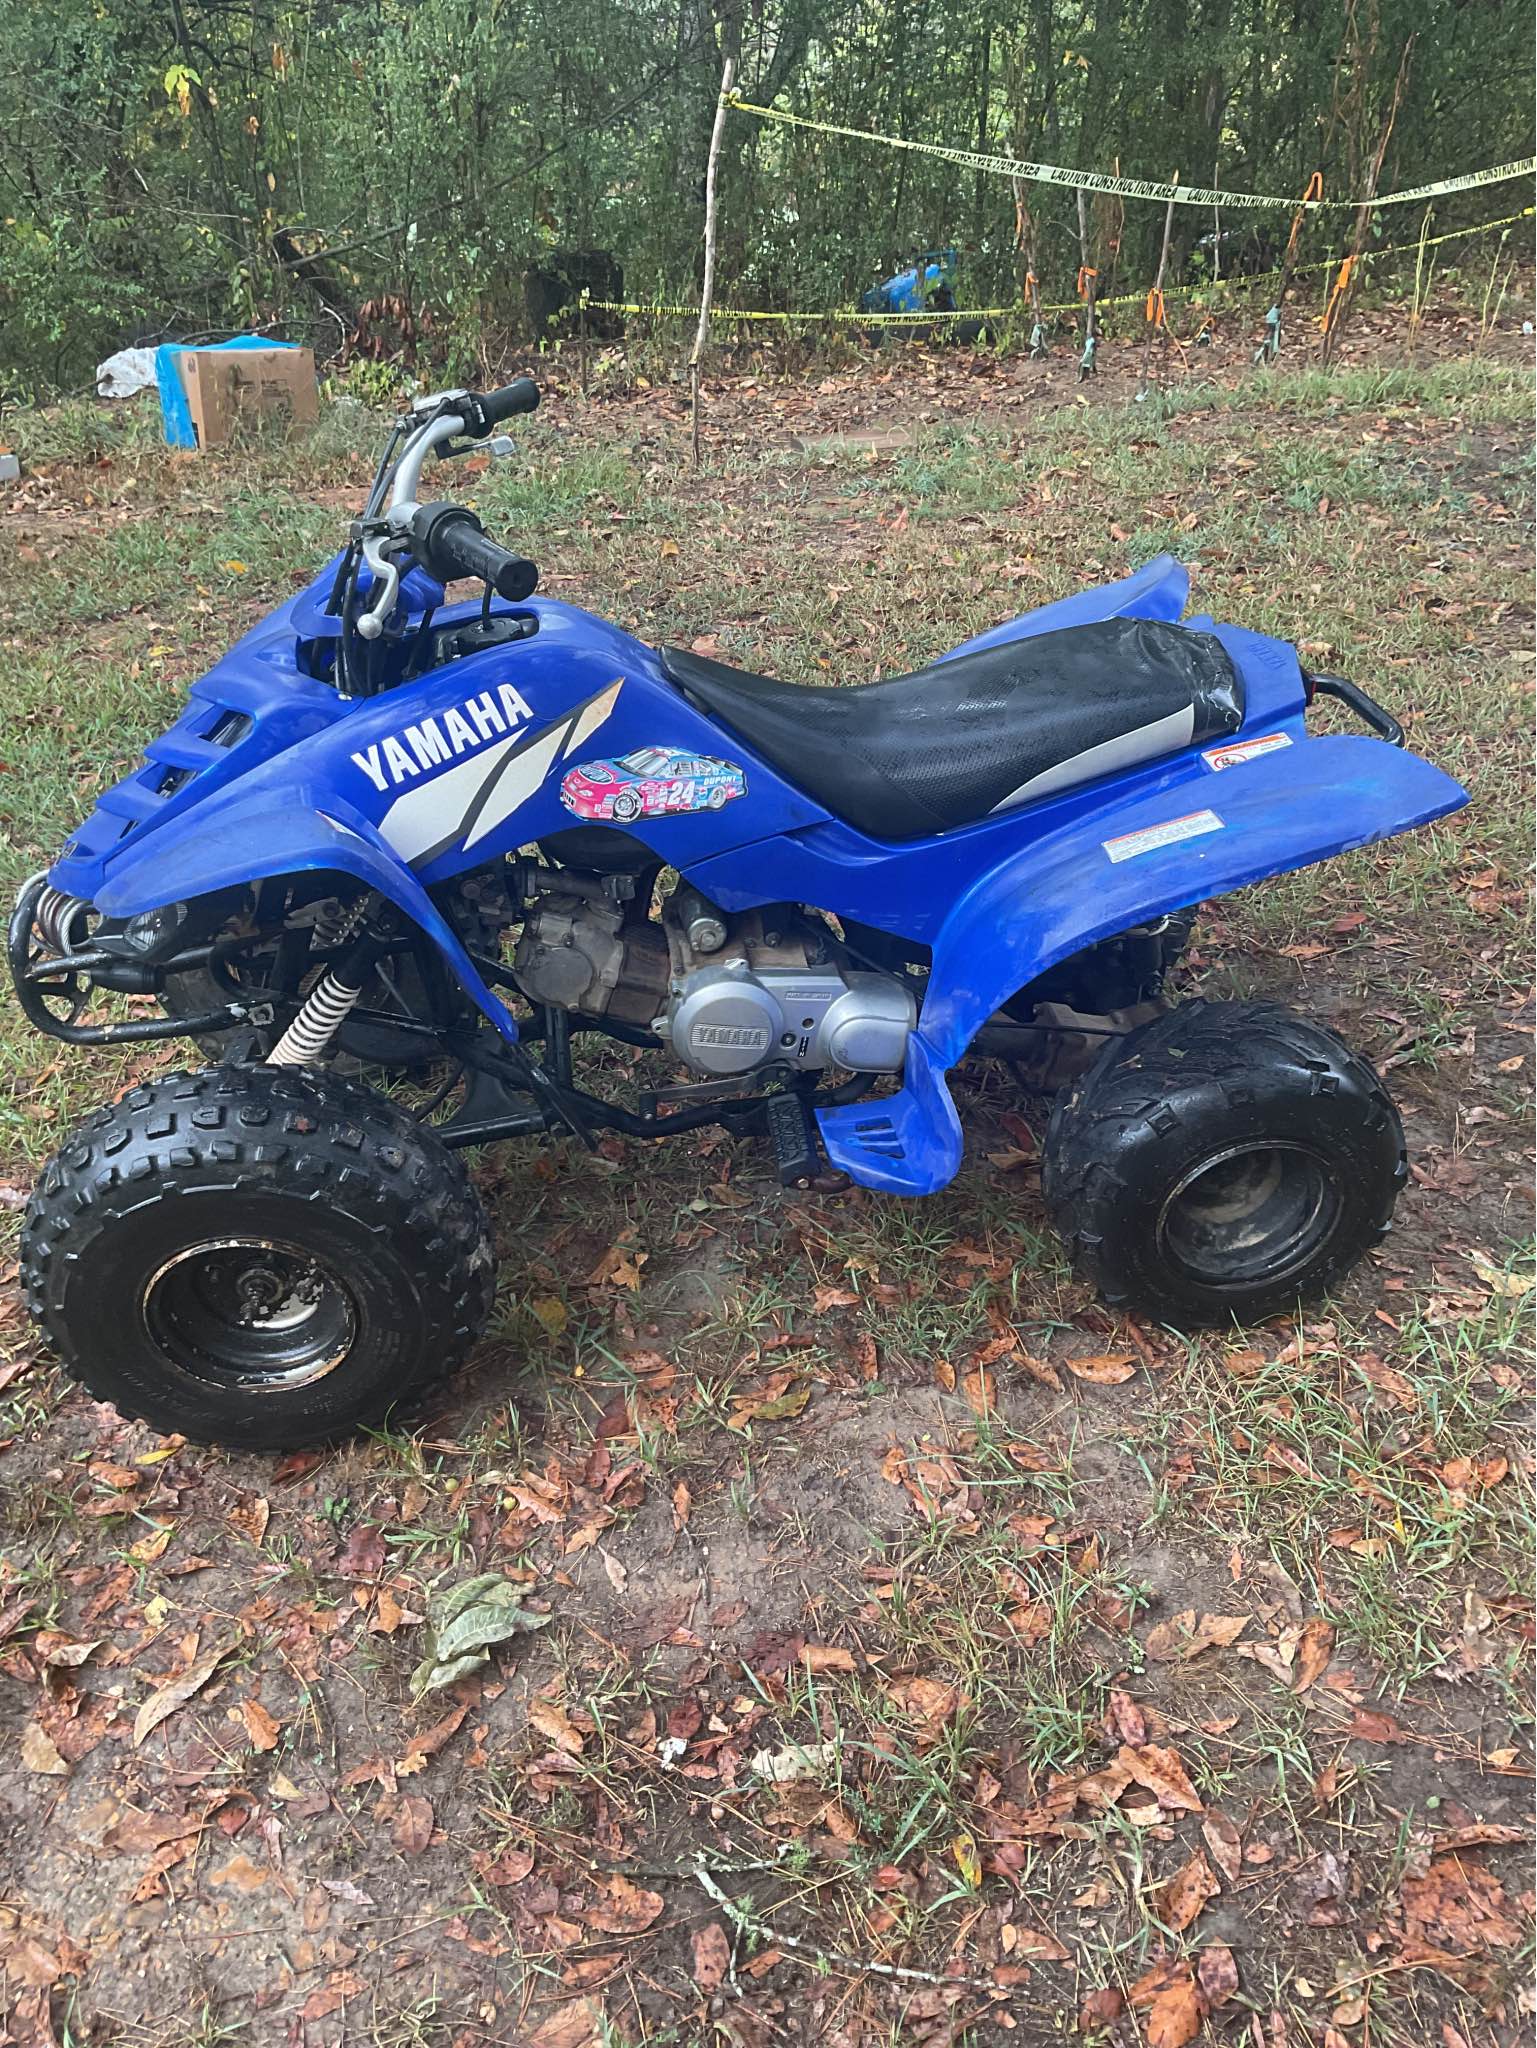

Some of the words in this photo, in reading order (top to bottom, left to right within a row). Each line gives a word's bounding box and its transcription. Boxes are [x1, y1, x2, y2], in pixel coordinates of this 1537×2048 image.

[1478, 159, 1534, 182] CONSTRUCTION
[1050, 168, 1091, 186] CAUTION
[1090, 173, 1154, 196] CONSTRUCTION
[1154, 184, 1178, 199] AREA
[1187, 188, 1225, 204] CAUTION
[351, 683, 535, 792] YAMAHA
[703, 775, 737, 785] DUPONT
[666, 780, 696, 806] 24
[699, 1027, 761, 1046] YAMAHA
